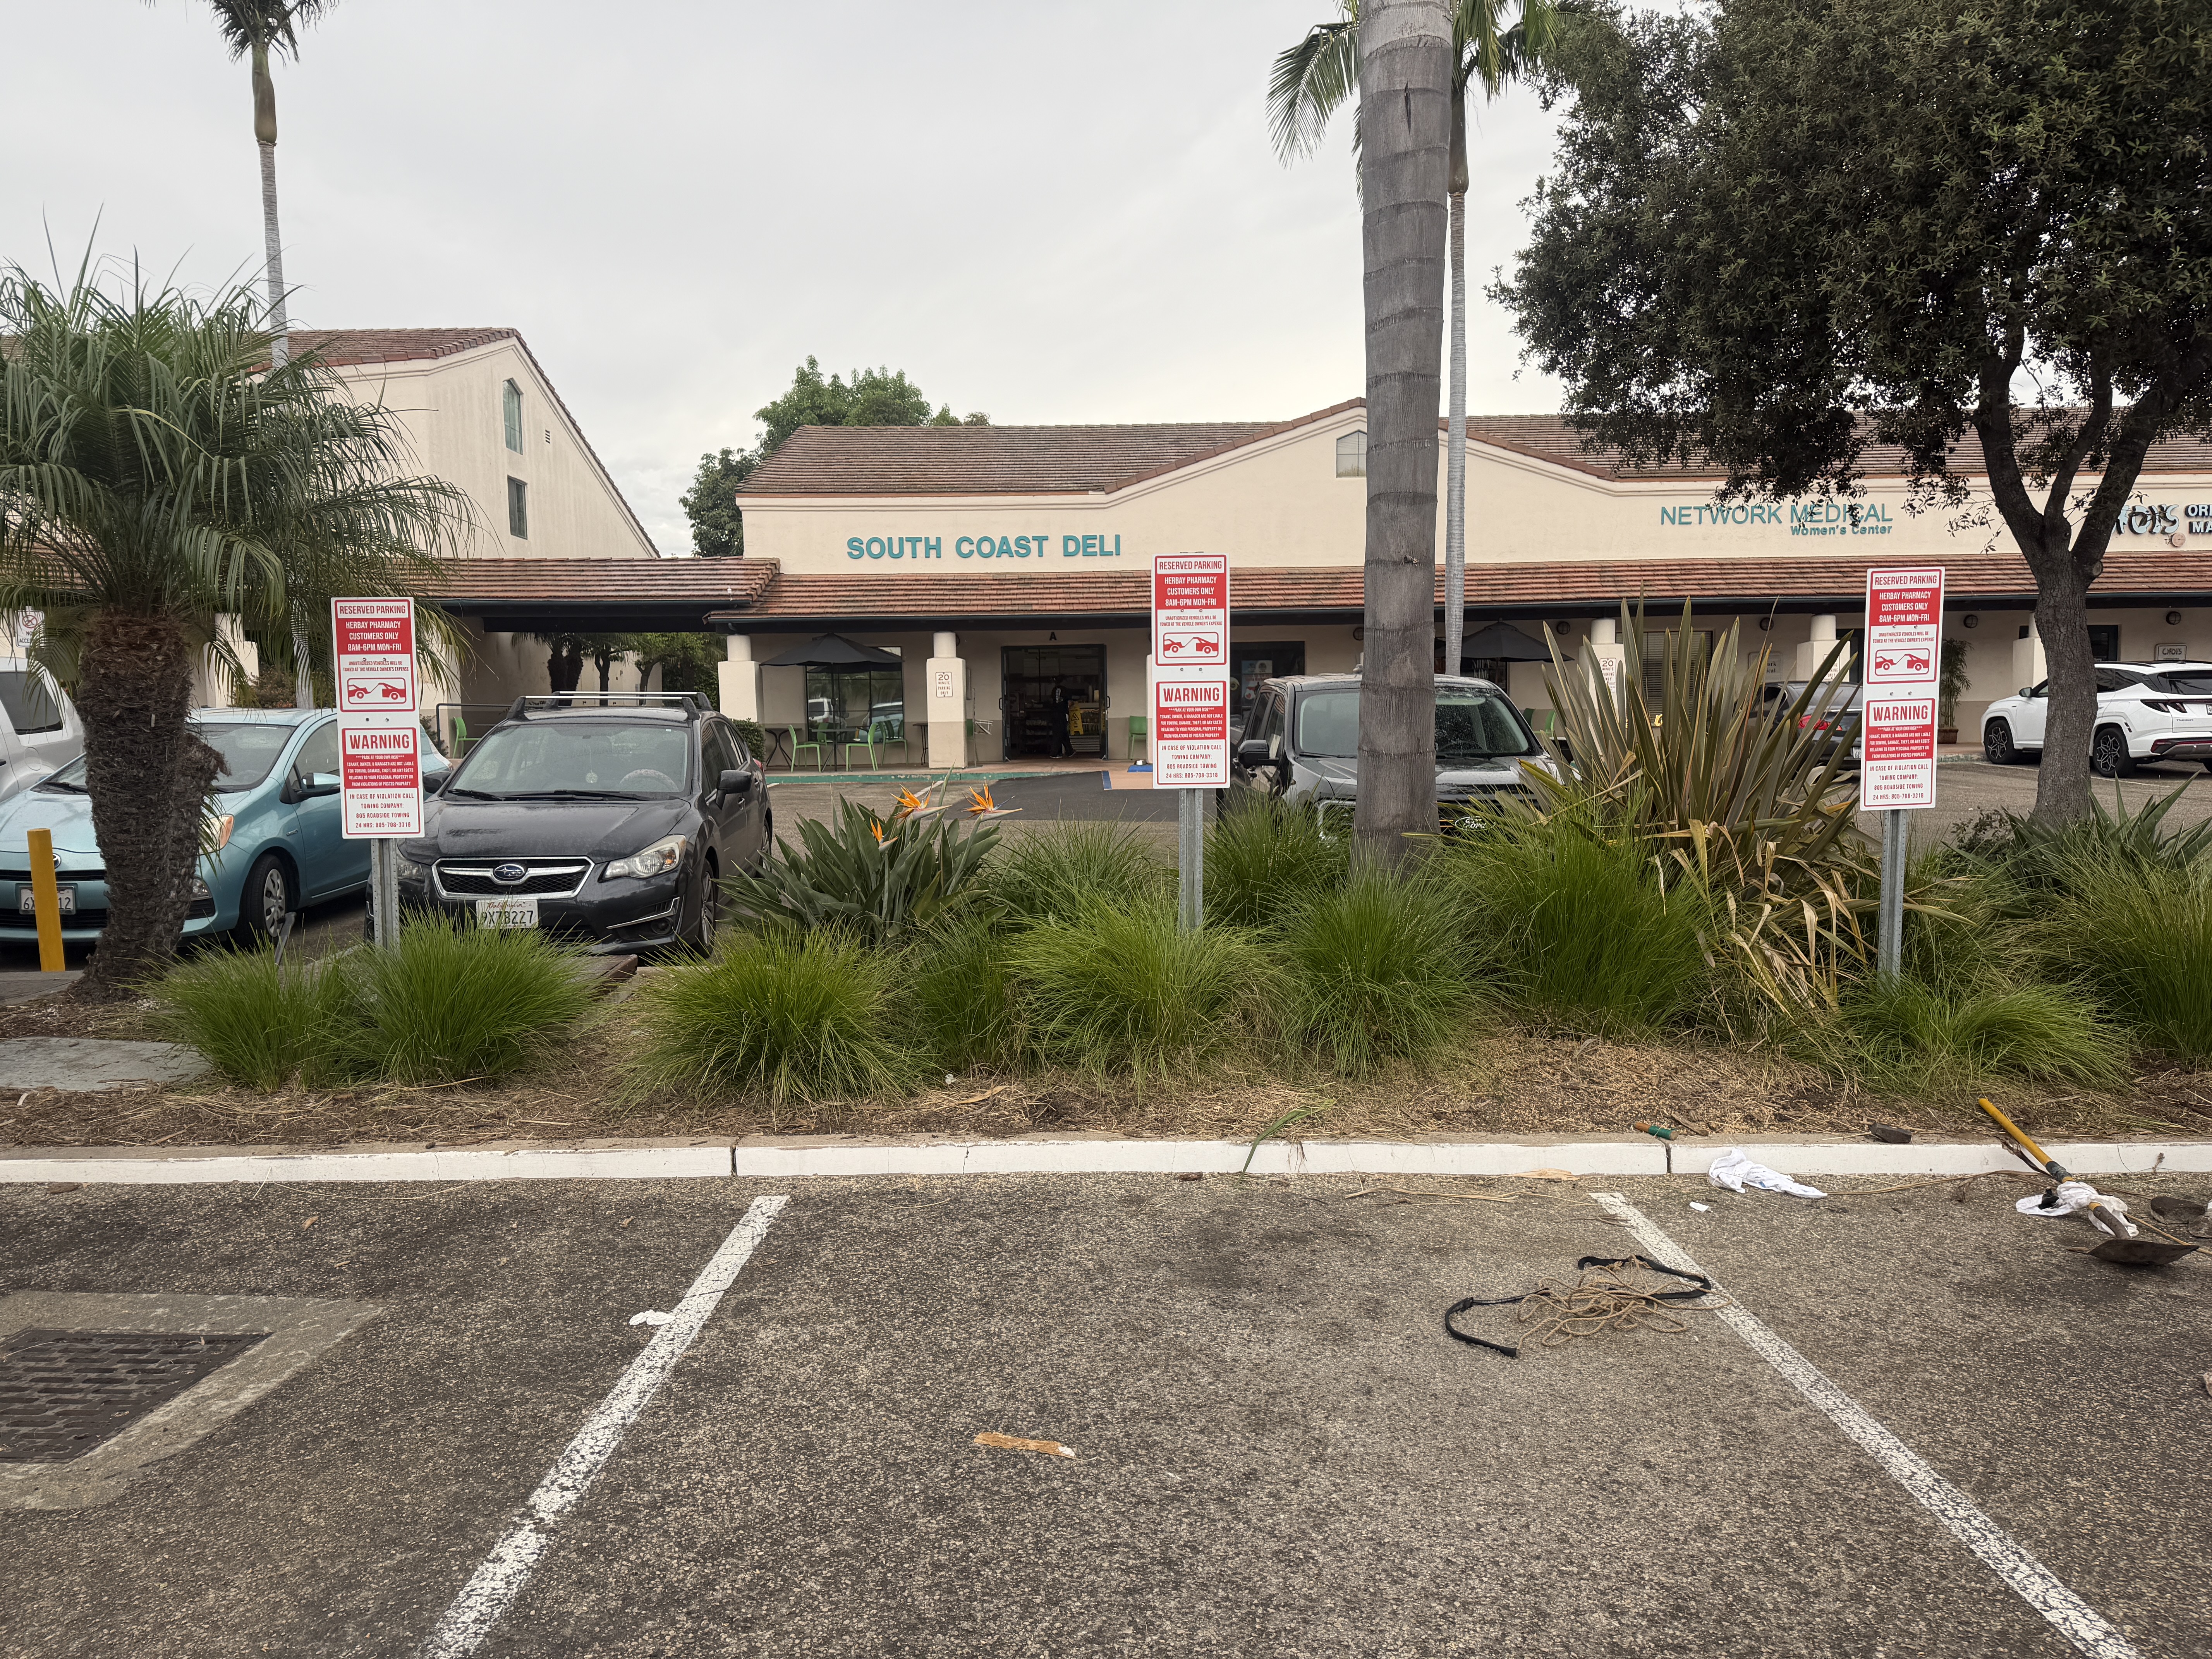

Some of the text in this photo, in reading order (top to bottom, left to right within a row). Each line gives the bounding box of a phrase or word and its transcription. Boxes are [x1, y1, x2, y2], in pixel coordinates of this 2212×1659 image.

[1661, 503, 1893, 525] NETWORK MEDICAL
[1790, 525, 1893, 536] Women's Center
[847, 534, 1121, 559] SOUTH COAST DELI
[1159, 560, 1222, 570] RESERVED PARKING
[1875, 575, 1937, 585] RESERVED PARKING
[1879, 591, 1931, 600] HERBAY PHARMACY
[340, 605, 406, 614] RESERVED PARKING
[1881, 603, 1913, 611] CUSTOMERS
[1879, 614, 1905, 622] 8AM-6PM
[1049, 632, 1057, 641] A
[1163, 687, 1219, 702] WARNING
[1873, 705, 1928, 721] WARNING
[349, 734, 409, 749] WARNING
[24, 897, 71, 909] 6X12
